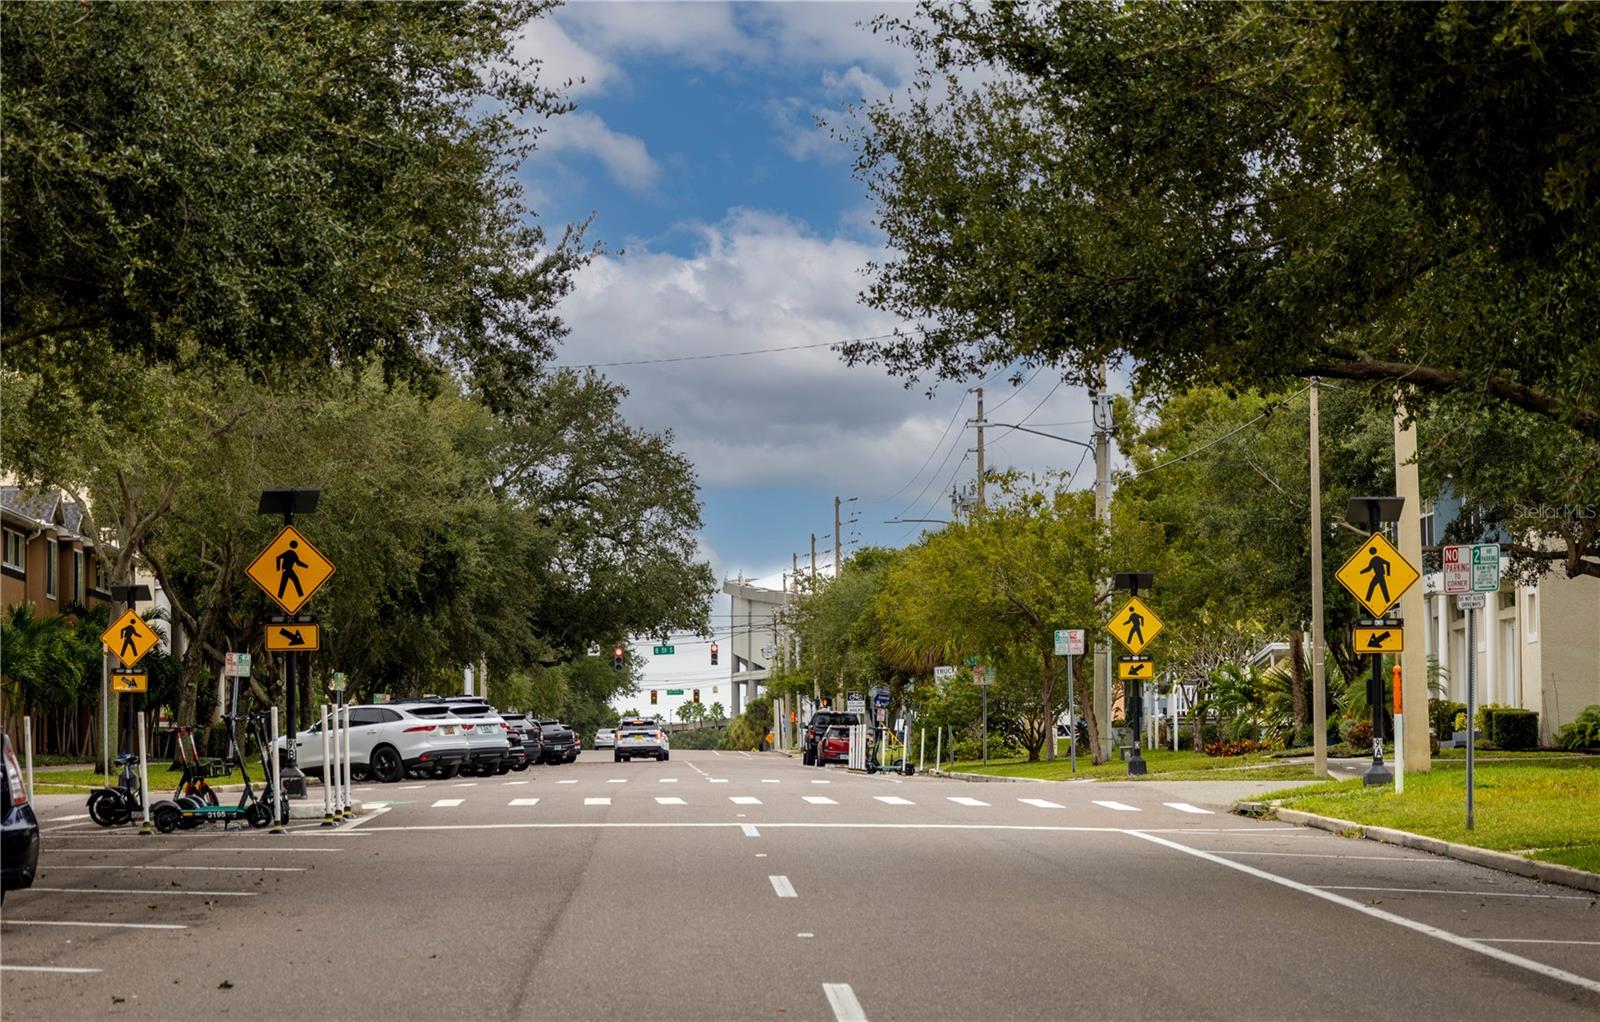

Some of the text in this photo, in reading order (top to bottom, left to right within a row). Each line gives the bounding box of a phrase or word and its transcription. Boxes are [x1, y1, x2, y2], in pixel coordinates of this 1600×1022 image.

[1445, 549, 1458, 562] NO
[1474, 549, 1480, 563] 2
[1445, 564, 1469, 572] PARKING
